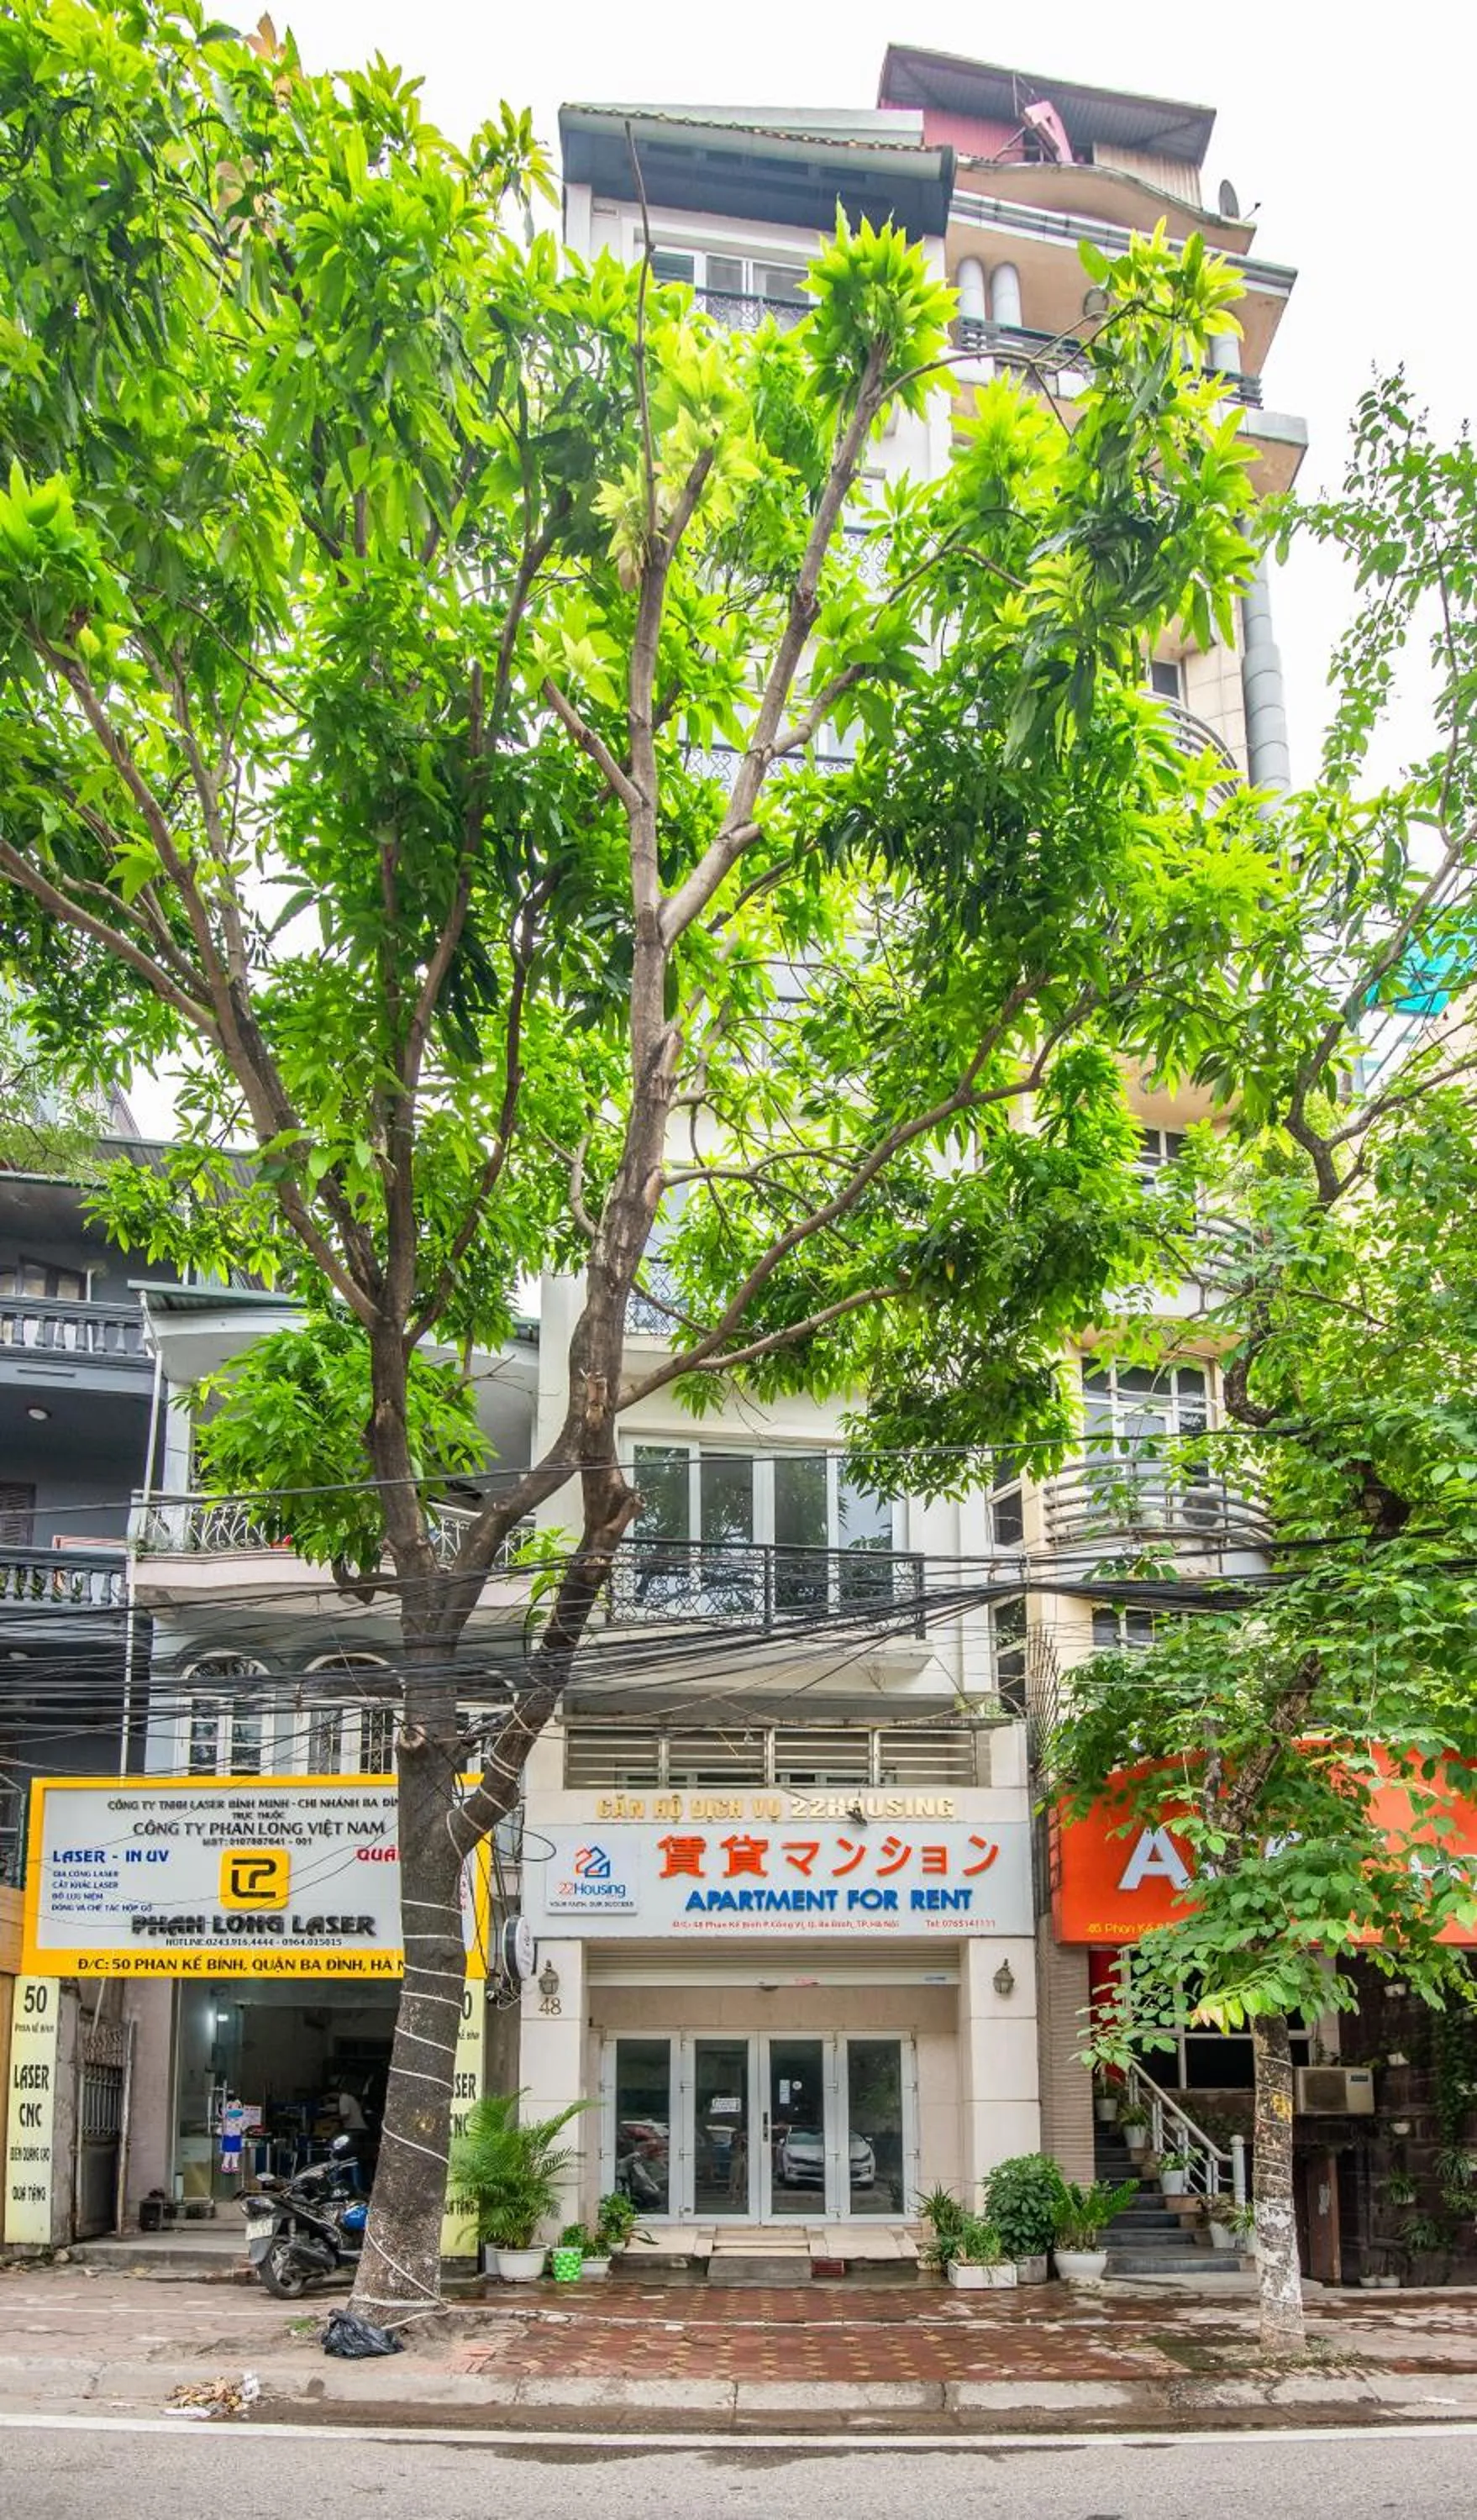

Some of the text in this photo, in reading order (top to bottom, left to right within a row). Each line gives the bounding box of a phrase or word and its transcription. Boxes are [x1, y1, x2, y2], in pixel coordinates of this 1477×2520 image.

[133, 1819, 385, 1838] CÔNG TY PHAN LONG VIỆT NAM
[53, 1851, 105, 1863] LASER
[126, 1851, 141, 1862] IN
[146, 1850, 169, 1862] UV
[686, 1888, 973, 1911] APARTMENT FOR RENT
[213, 1915, 284, 1935] LONG
[292, 1914, 376, 1936] LASER
[78, 1958, 108, 1970] Đ/C:
[112, 1958, 130, 1970] 50
[134, 1959, 177, 1970] PHAN
[182, 1956, 202, 1970] KẾ
[252, 1956, 294, 1973] QUẬN
[301, 1959, 321, 1971] BA
[24, 1985, 47, 2013] 50
[539, 1998, 562, 2015] 48
[13, 2065, 50, 2090] LASER
[455, 2072, 476, 2099] SER
[19, 2103, 42, 2127] CNC
